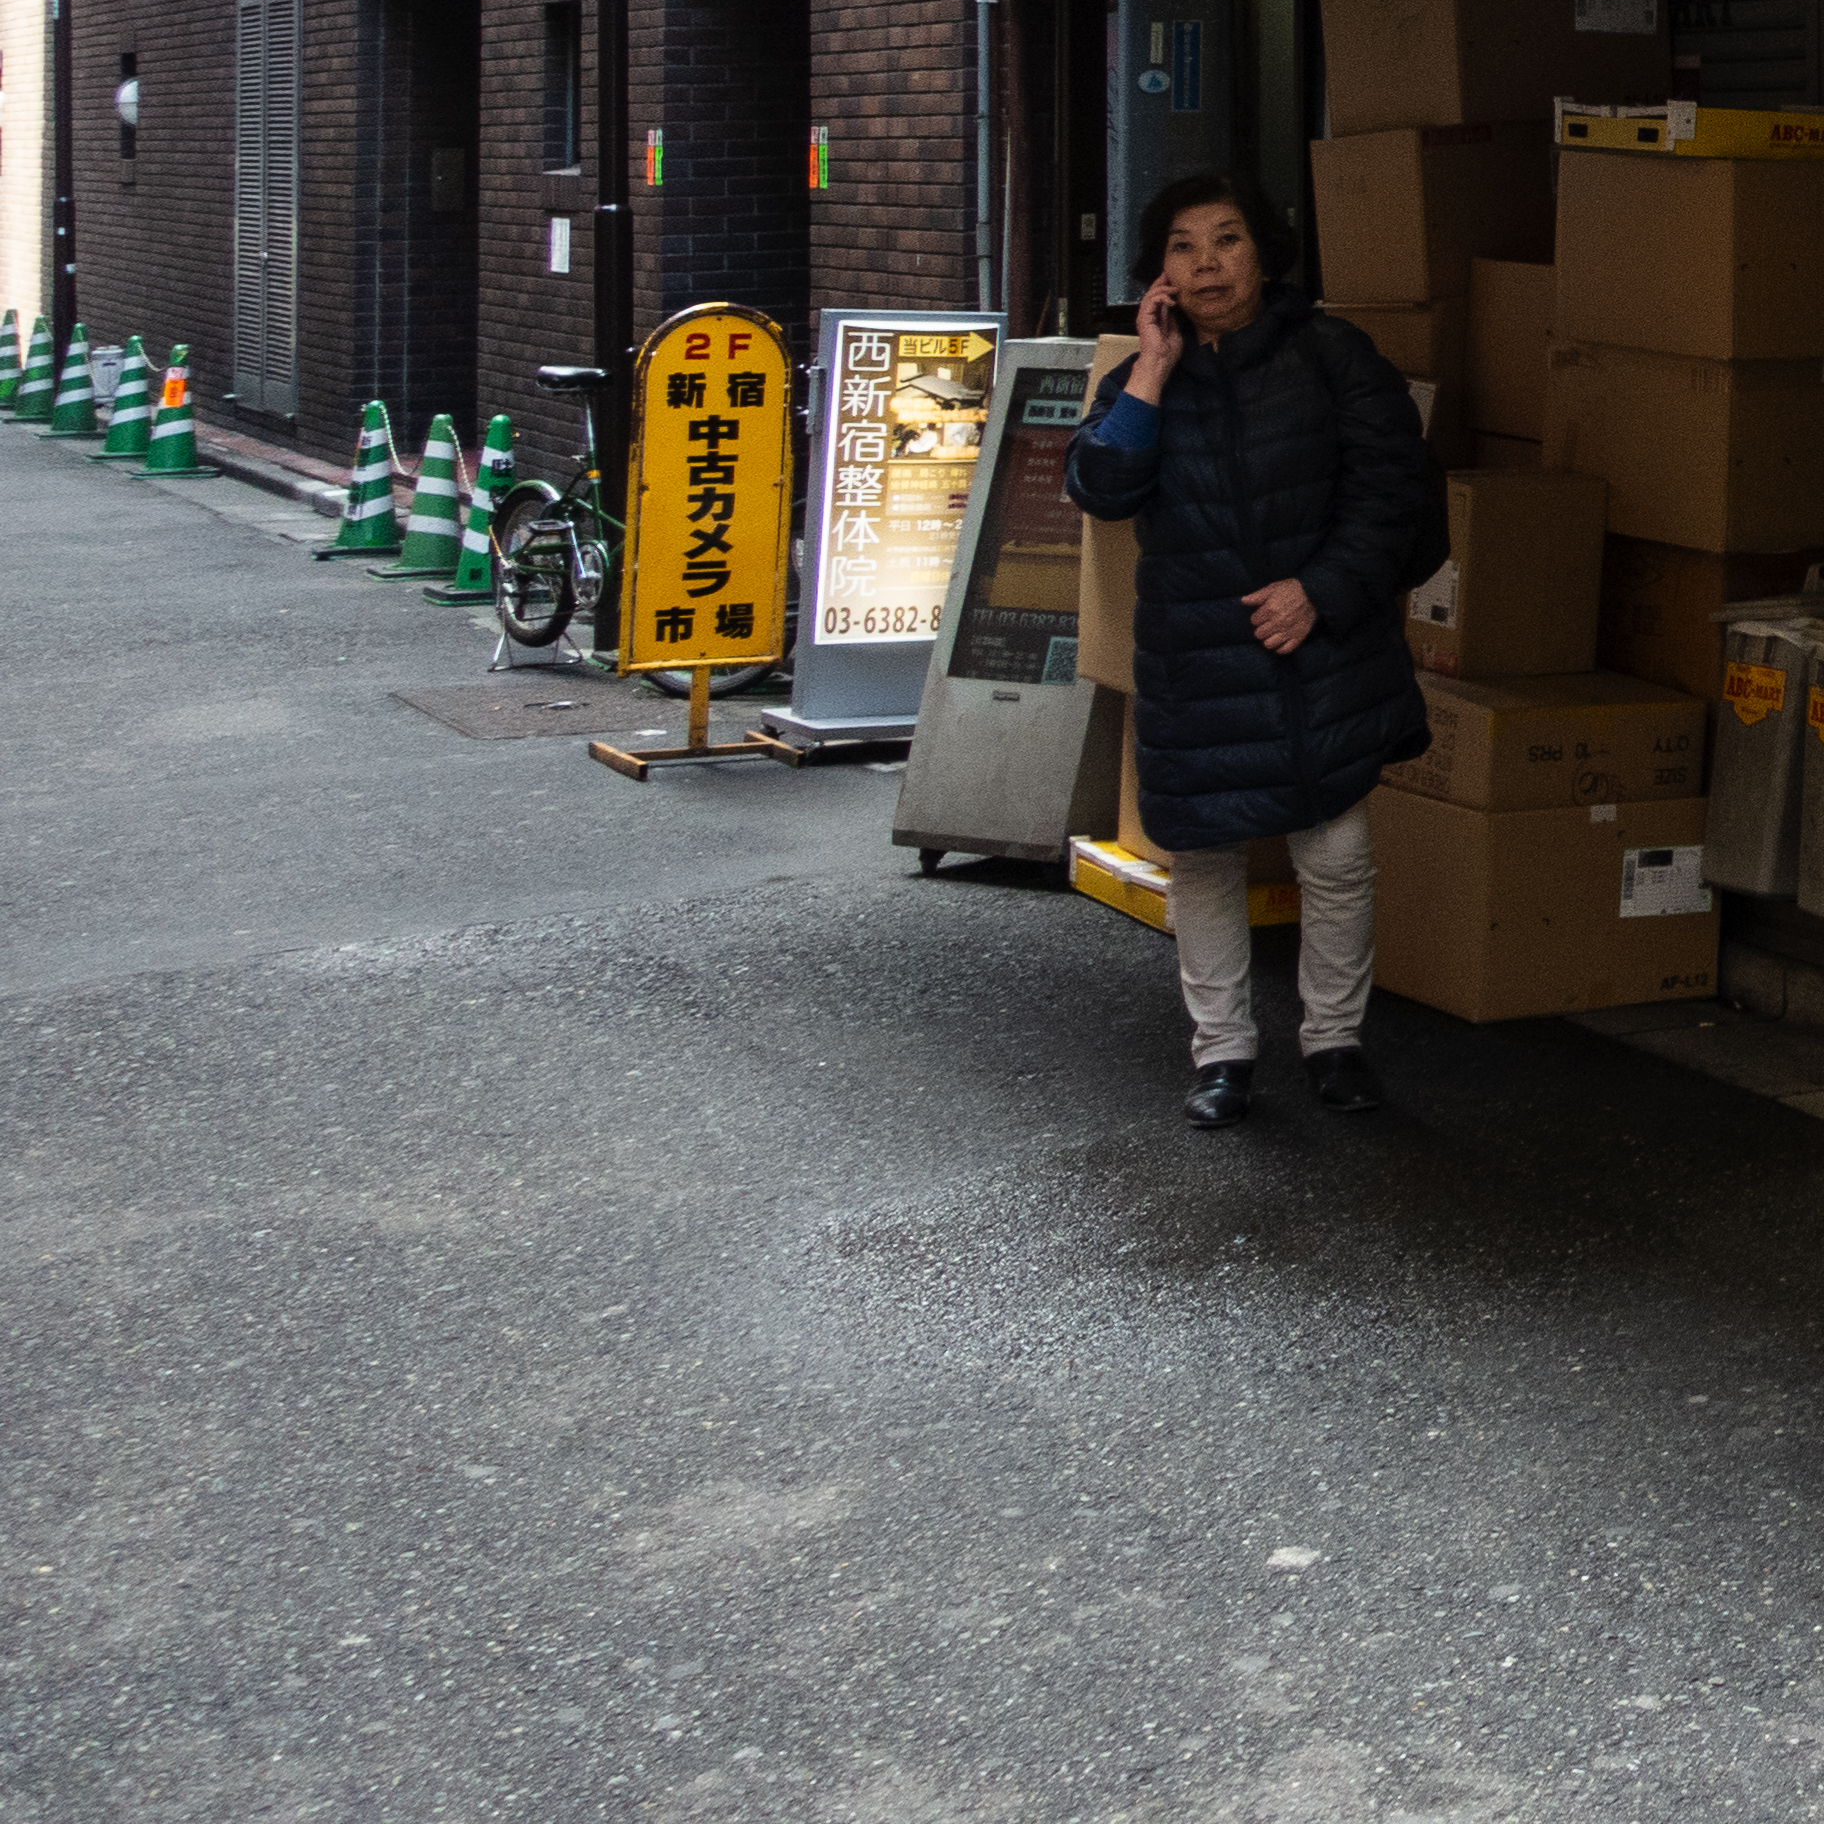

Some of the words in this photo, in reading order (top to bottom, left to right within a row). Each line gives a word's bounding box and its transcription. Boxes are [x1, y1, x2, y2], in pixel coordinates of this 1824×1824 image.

[903, 336, 970, 356] 当ビル5F
[666, 372, 767, 409] 新宿
[829, 331, 895, 598] 西新宿整体院
[682, 415, 740, 599] 中古カメラ
[655, 603, 755, 644] 市場
[824, 605, 942, 636] 03-6382-8
